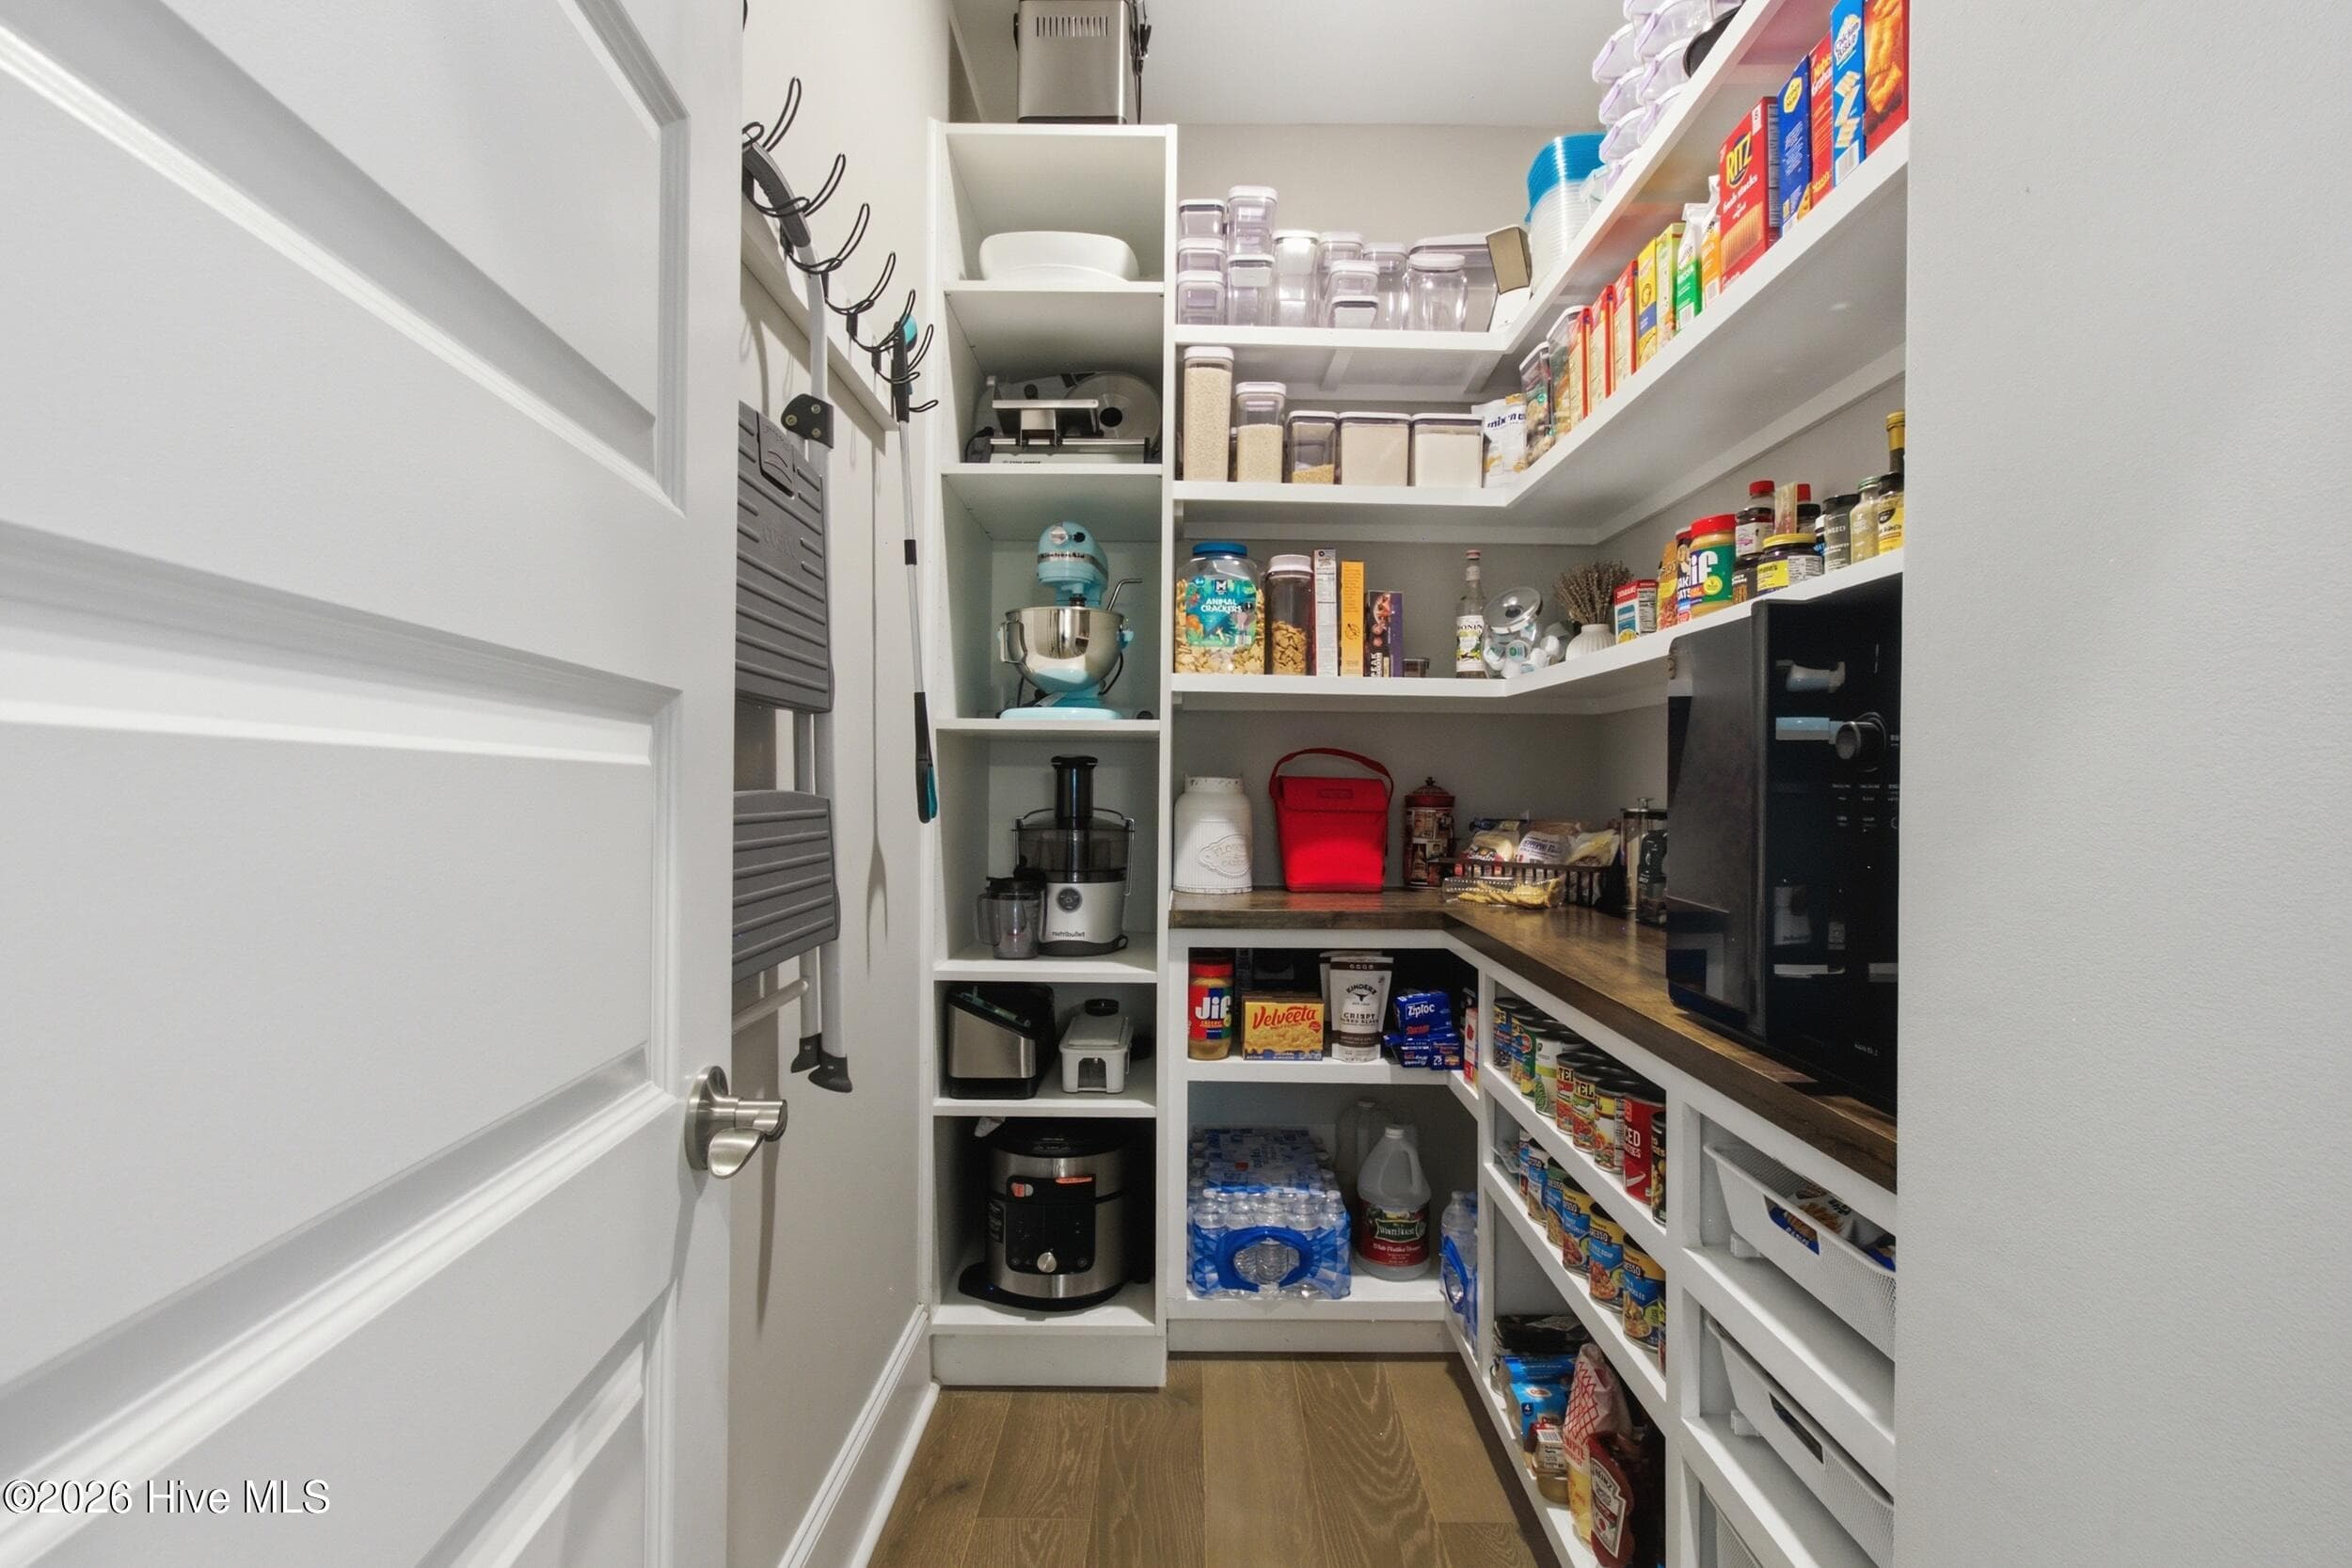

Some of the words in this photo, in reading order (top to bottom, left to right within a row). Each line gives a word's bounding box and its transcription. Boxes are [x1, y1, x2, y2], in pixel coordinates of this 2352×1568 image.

[1726, 131, 1753, 186] RITZ
[1691, 550, 1719, 585] if
[1200, 604, 1243, 614] CRACKERS
[1205, 597, 1237, 606] ANIMAL
[1195, 995, 1232, 1020] Jif
[1252, 1006, 1318, 1030] Velveeta
[1407, 1003, 1436, 1019] Ziploc
